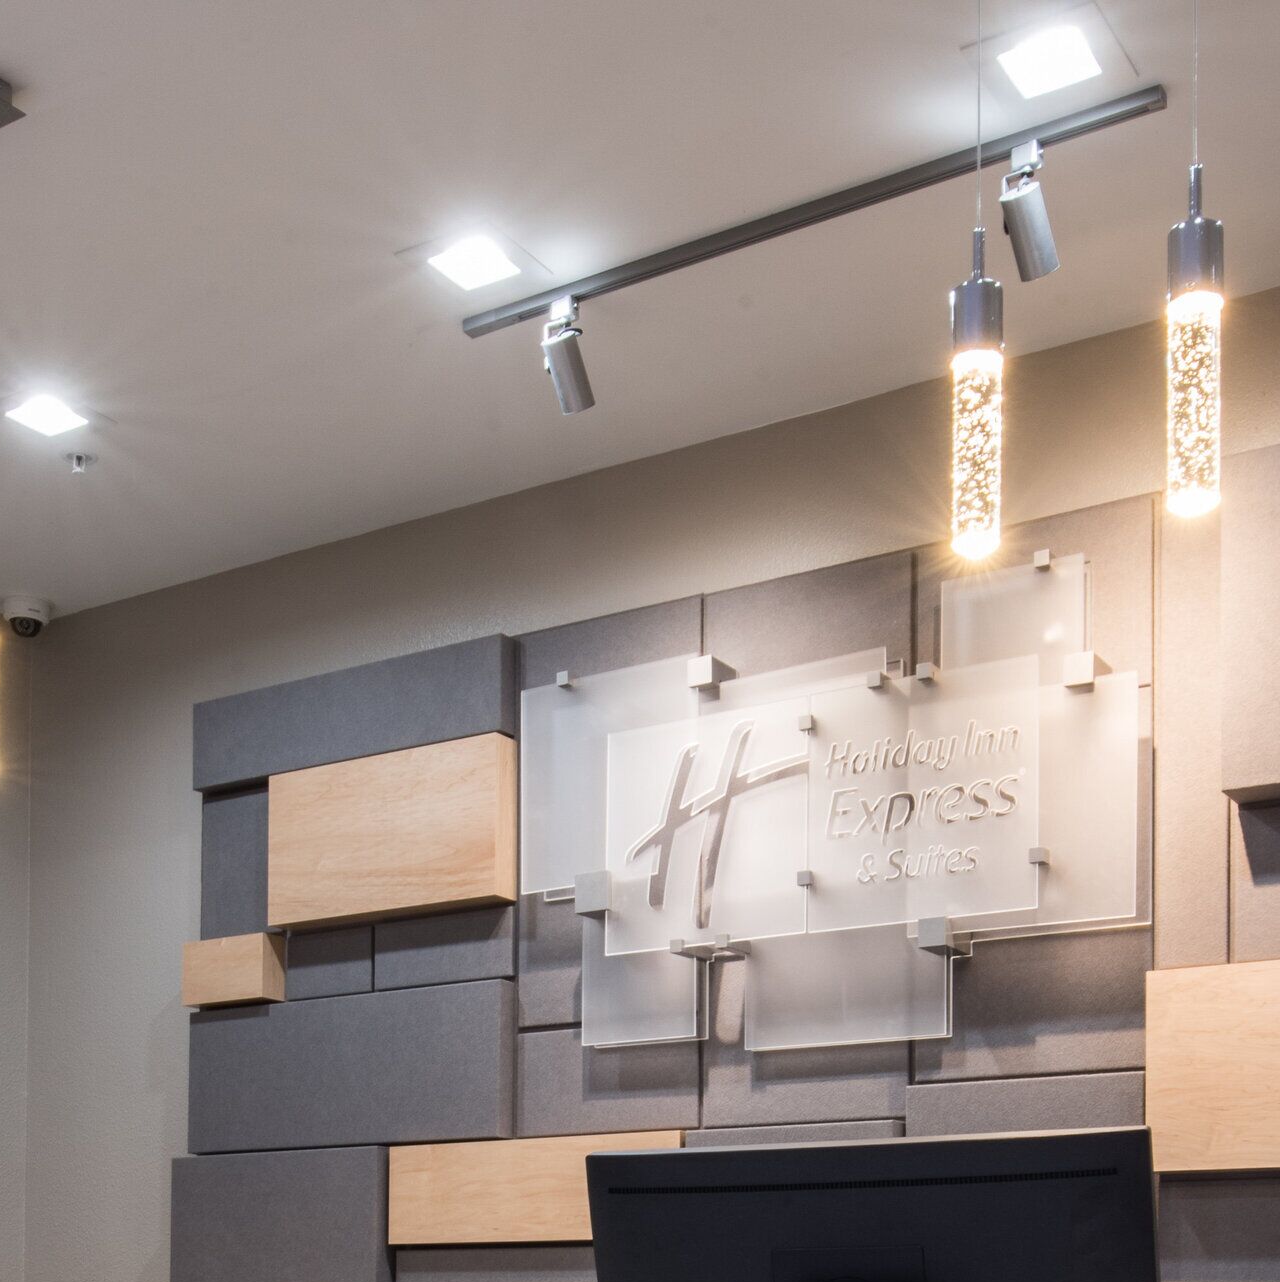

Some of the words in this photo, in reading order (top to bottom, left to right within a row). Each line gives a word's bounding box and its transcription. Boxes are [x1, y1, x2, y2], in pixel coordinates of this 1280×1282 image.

[825, 730, 958, 777] Holiday
[962, 719, 1020, 760] Inn
[825, 771, 1019, 845] Express
[856, 857, 879, 885] &
[880, 843, 980, 881] Suites
